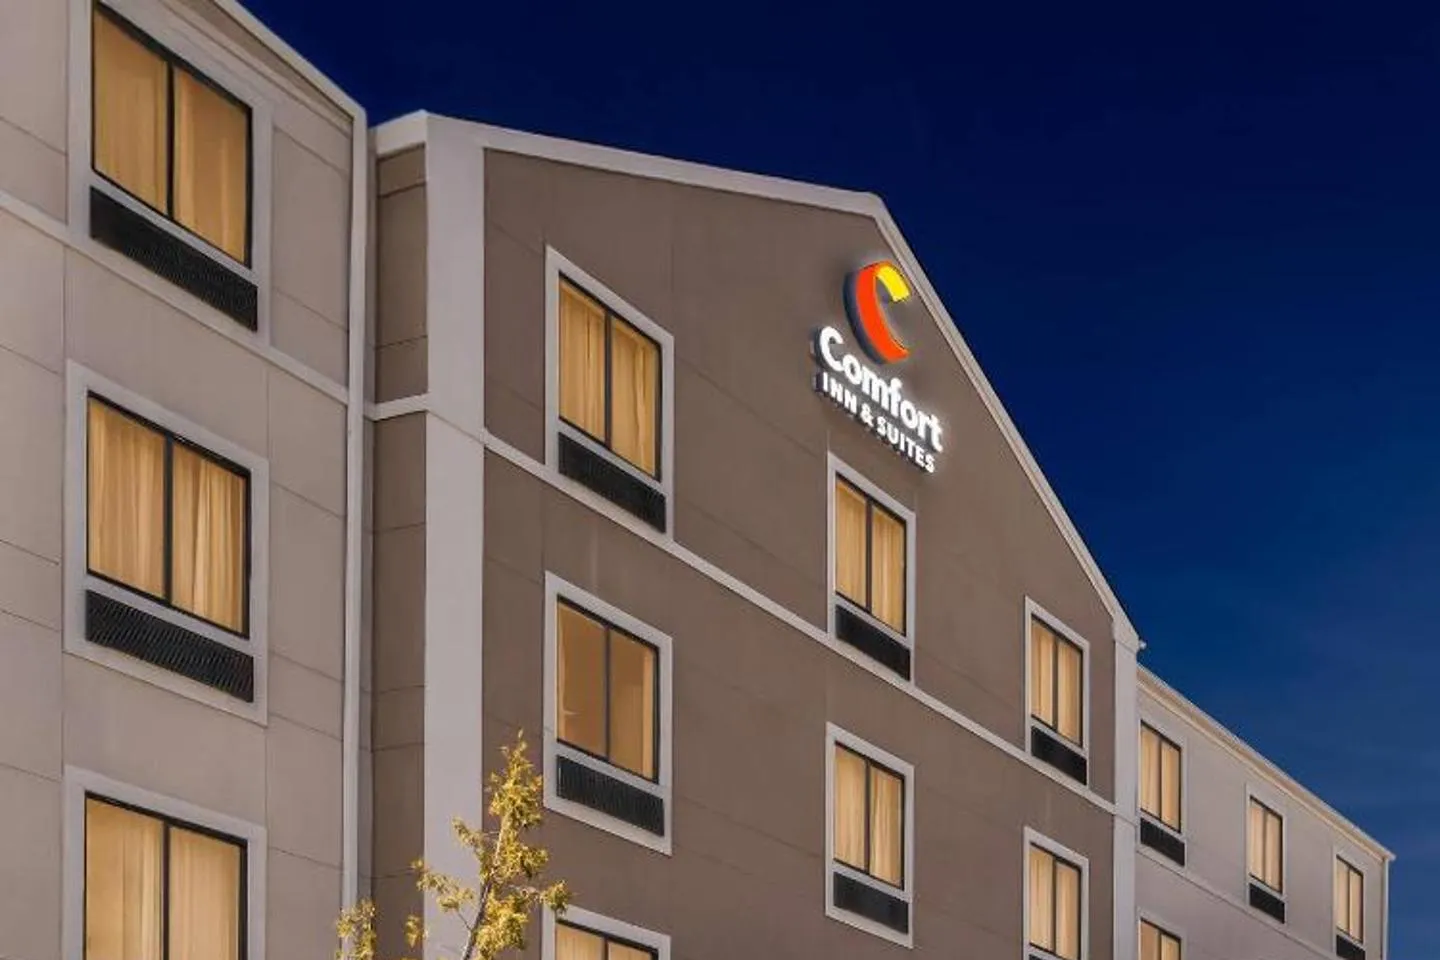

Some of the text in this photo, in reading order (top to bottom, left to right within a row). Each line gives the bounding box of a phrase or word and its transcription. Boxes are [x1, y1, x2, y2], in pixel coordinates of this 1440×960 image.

[819, 325, 943, 452] Comfort
[821, 371, 935, 473] INN & SUITES
